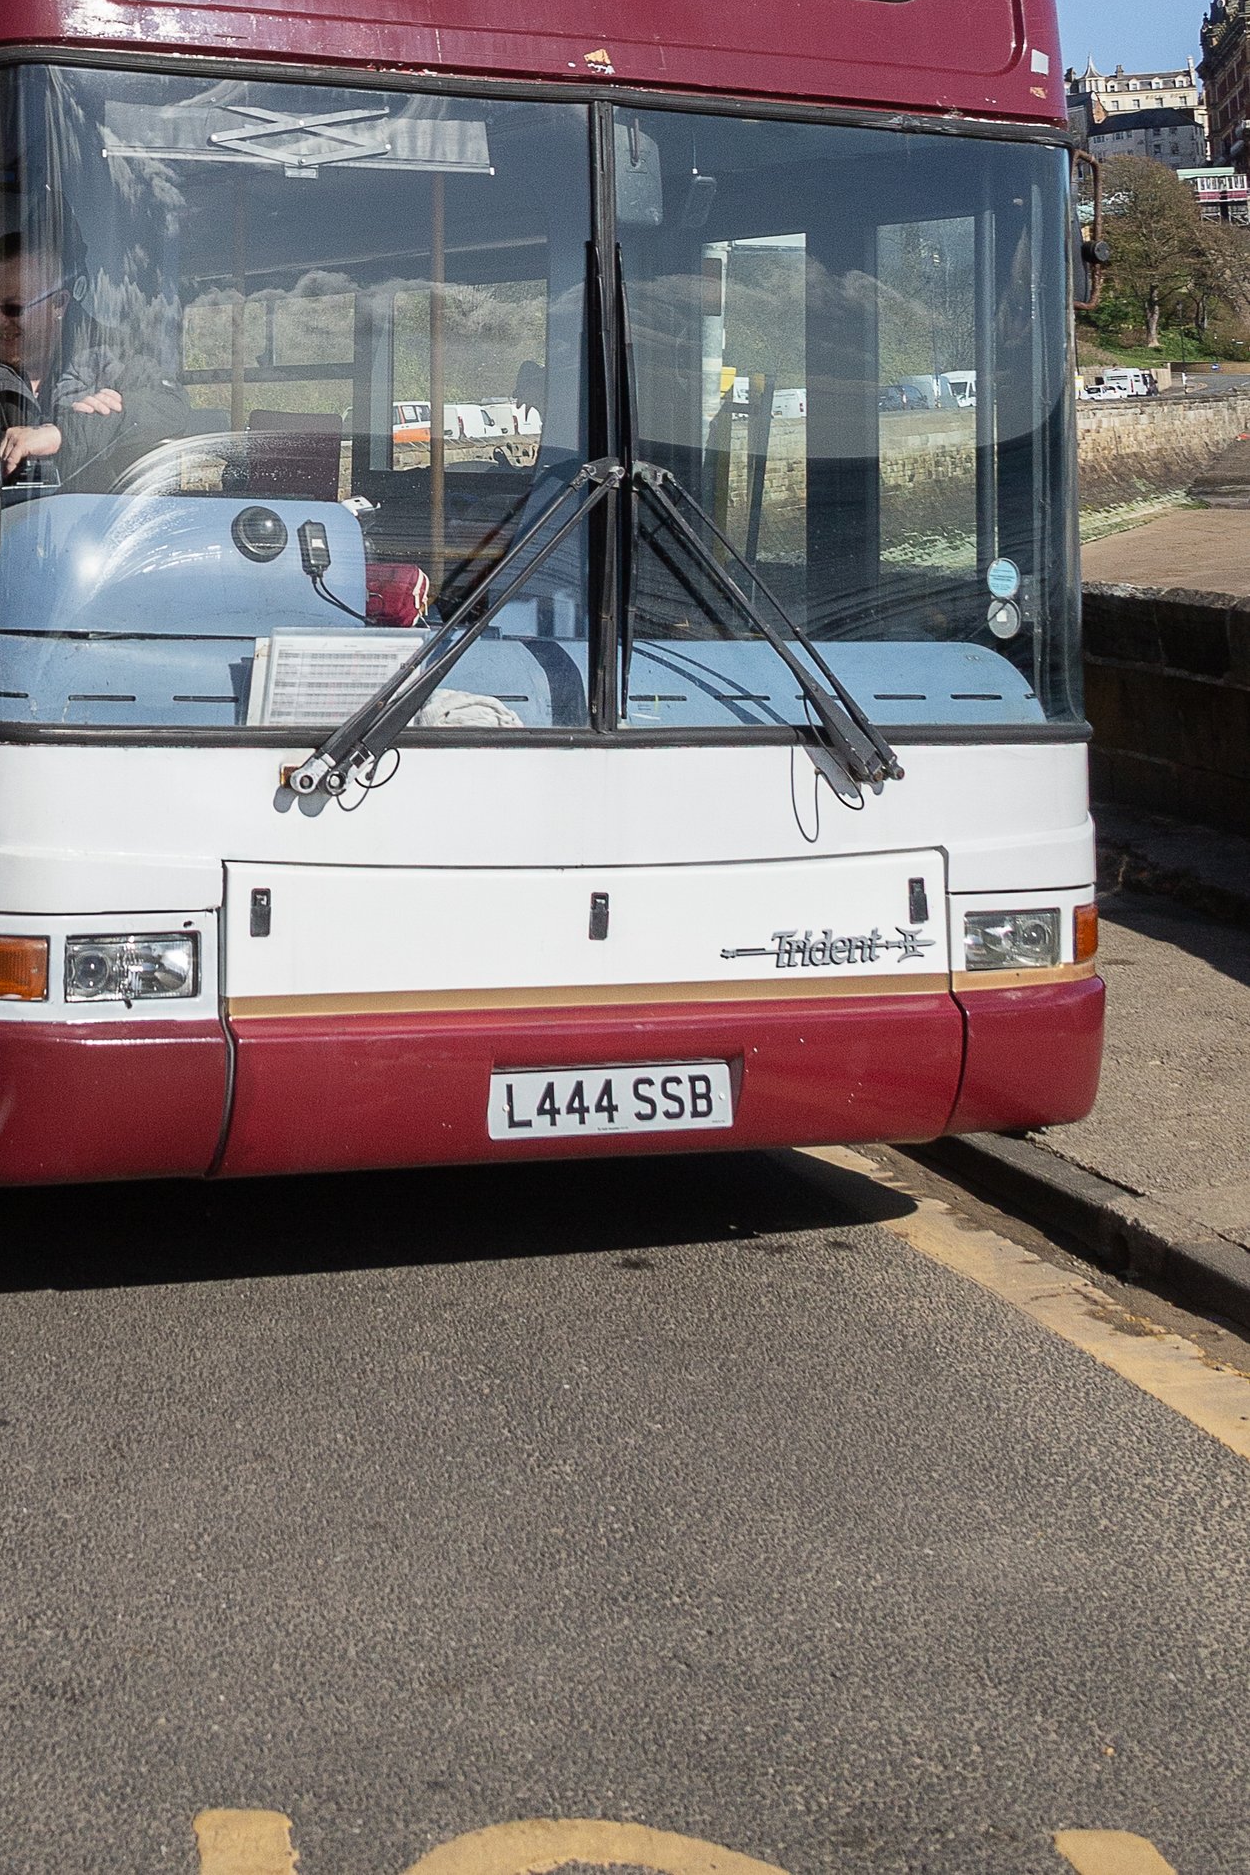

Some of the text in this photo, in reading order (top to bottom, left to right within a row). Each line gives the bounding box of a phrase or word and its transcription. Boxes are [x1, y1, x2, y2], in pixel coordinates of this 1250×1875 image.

[771, 927, 882, 968] Trident
[506, 1074, 712, 1129] L444 SSB
